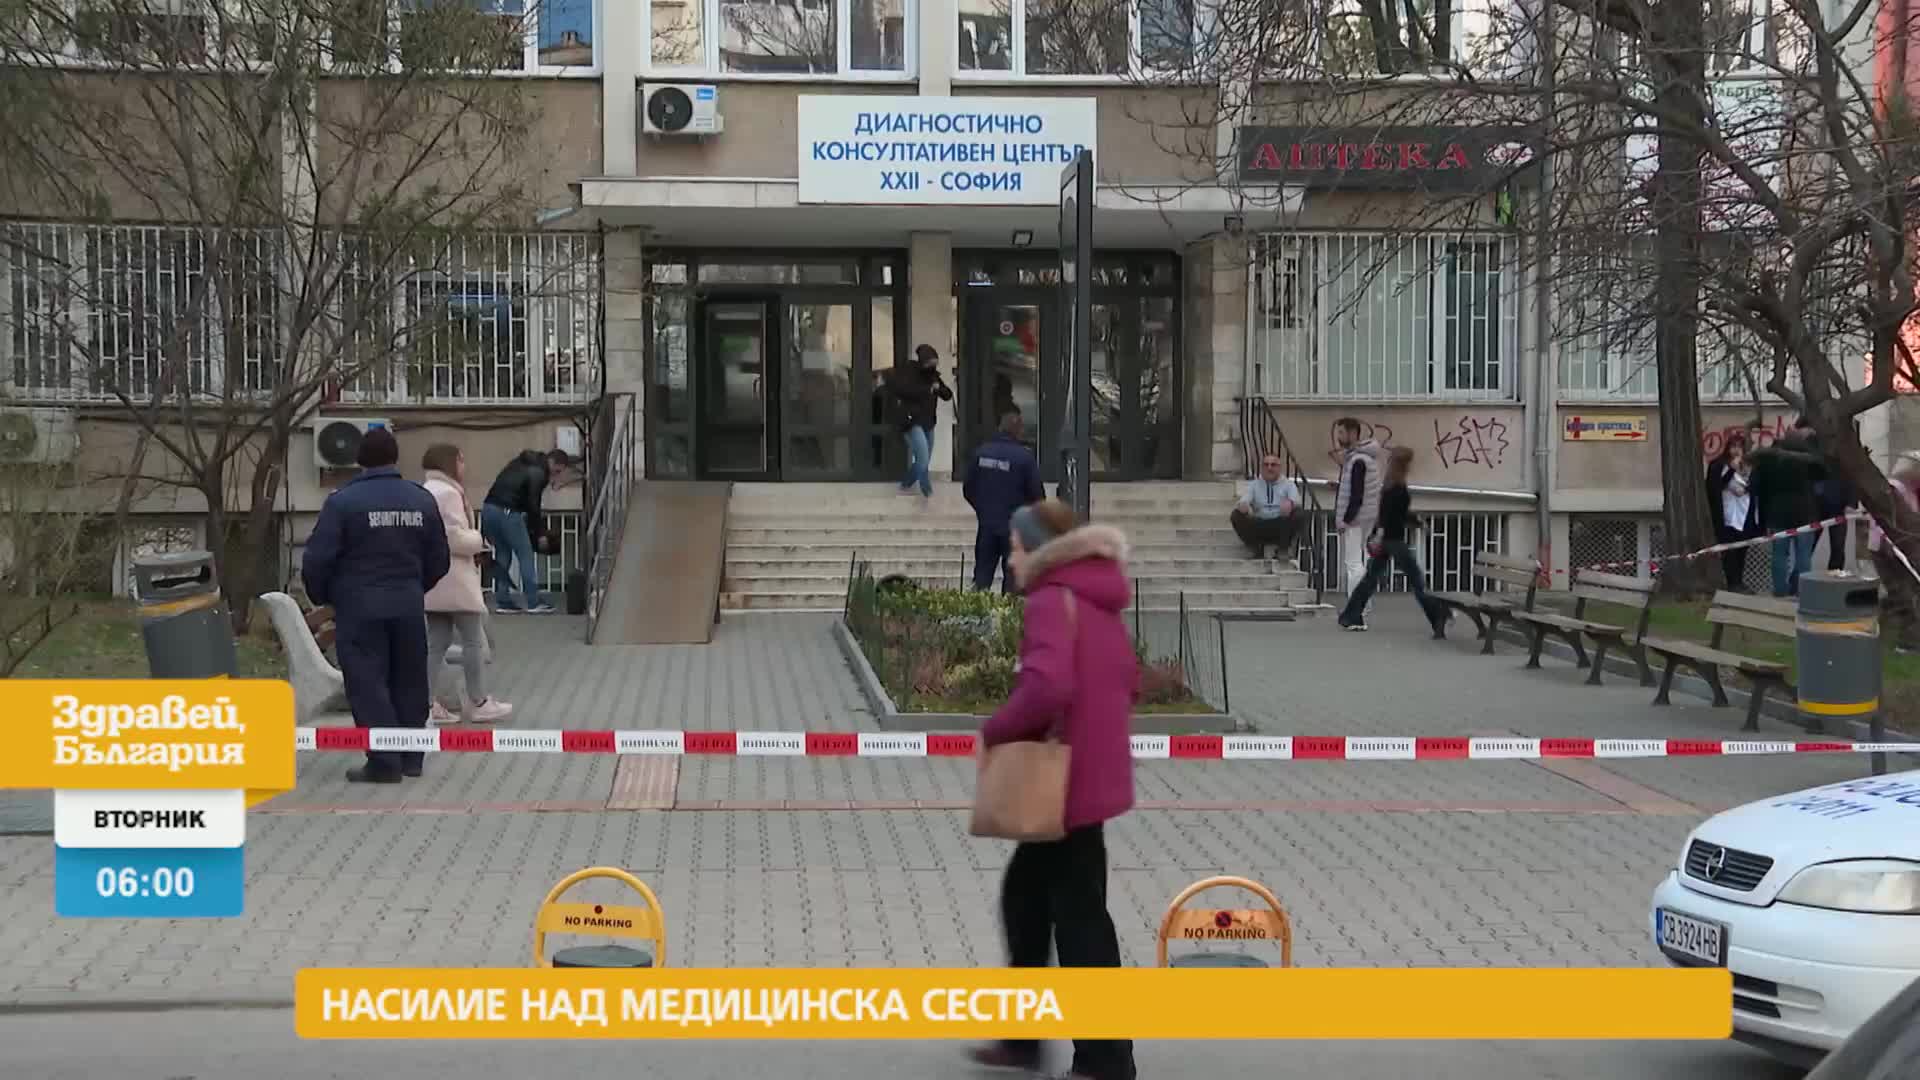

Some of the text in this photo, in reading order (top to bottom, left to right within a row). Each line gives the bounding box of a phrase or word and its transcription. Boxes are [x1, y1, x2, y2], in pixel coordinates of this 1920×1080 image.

[854, 112, 1043, 136] ДИАГНОСТИЧНО
[812, 141, 996, 162] КОНСУЛТАТИВЕН
[1248, 143, 1473, 170] АПТЕКА
[879, 171, 920, 191] XXII
[940, 172, 1022, 192] СОФИЯ
[564, 915, 633, 929] NO PARKING
[1184, 927, 1267, 940] NO PARKING
